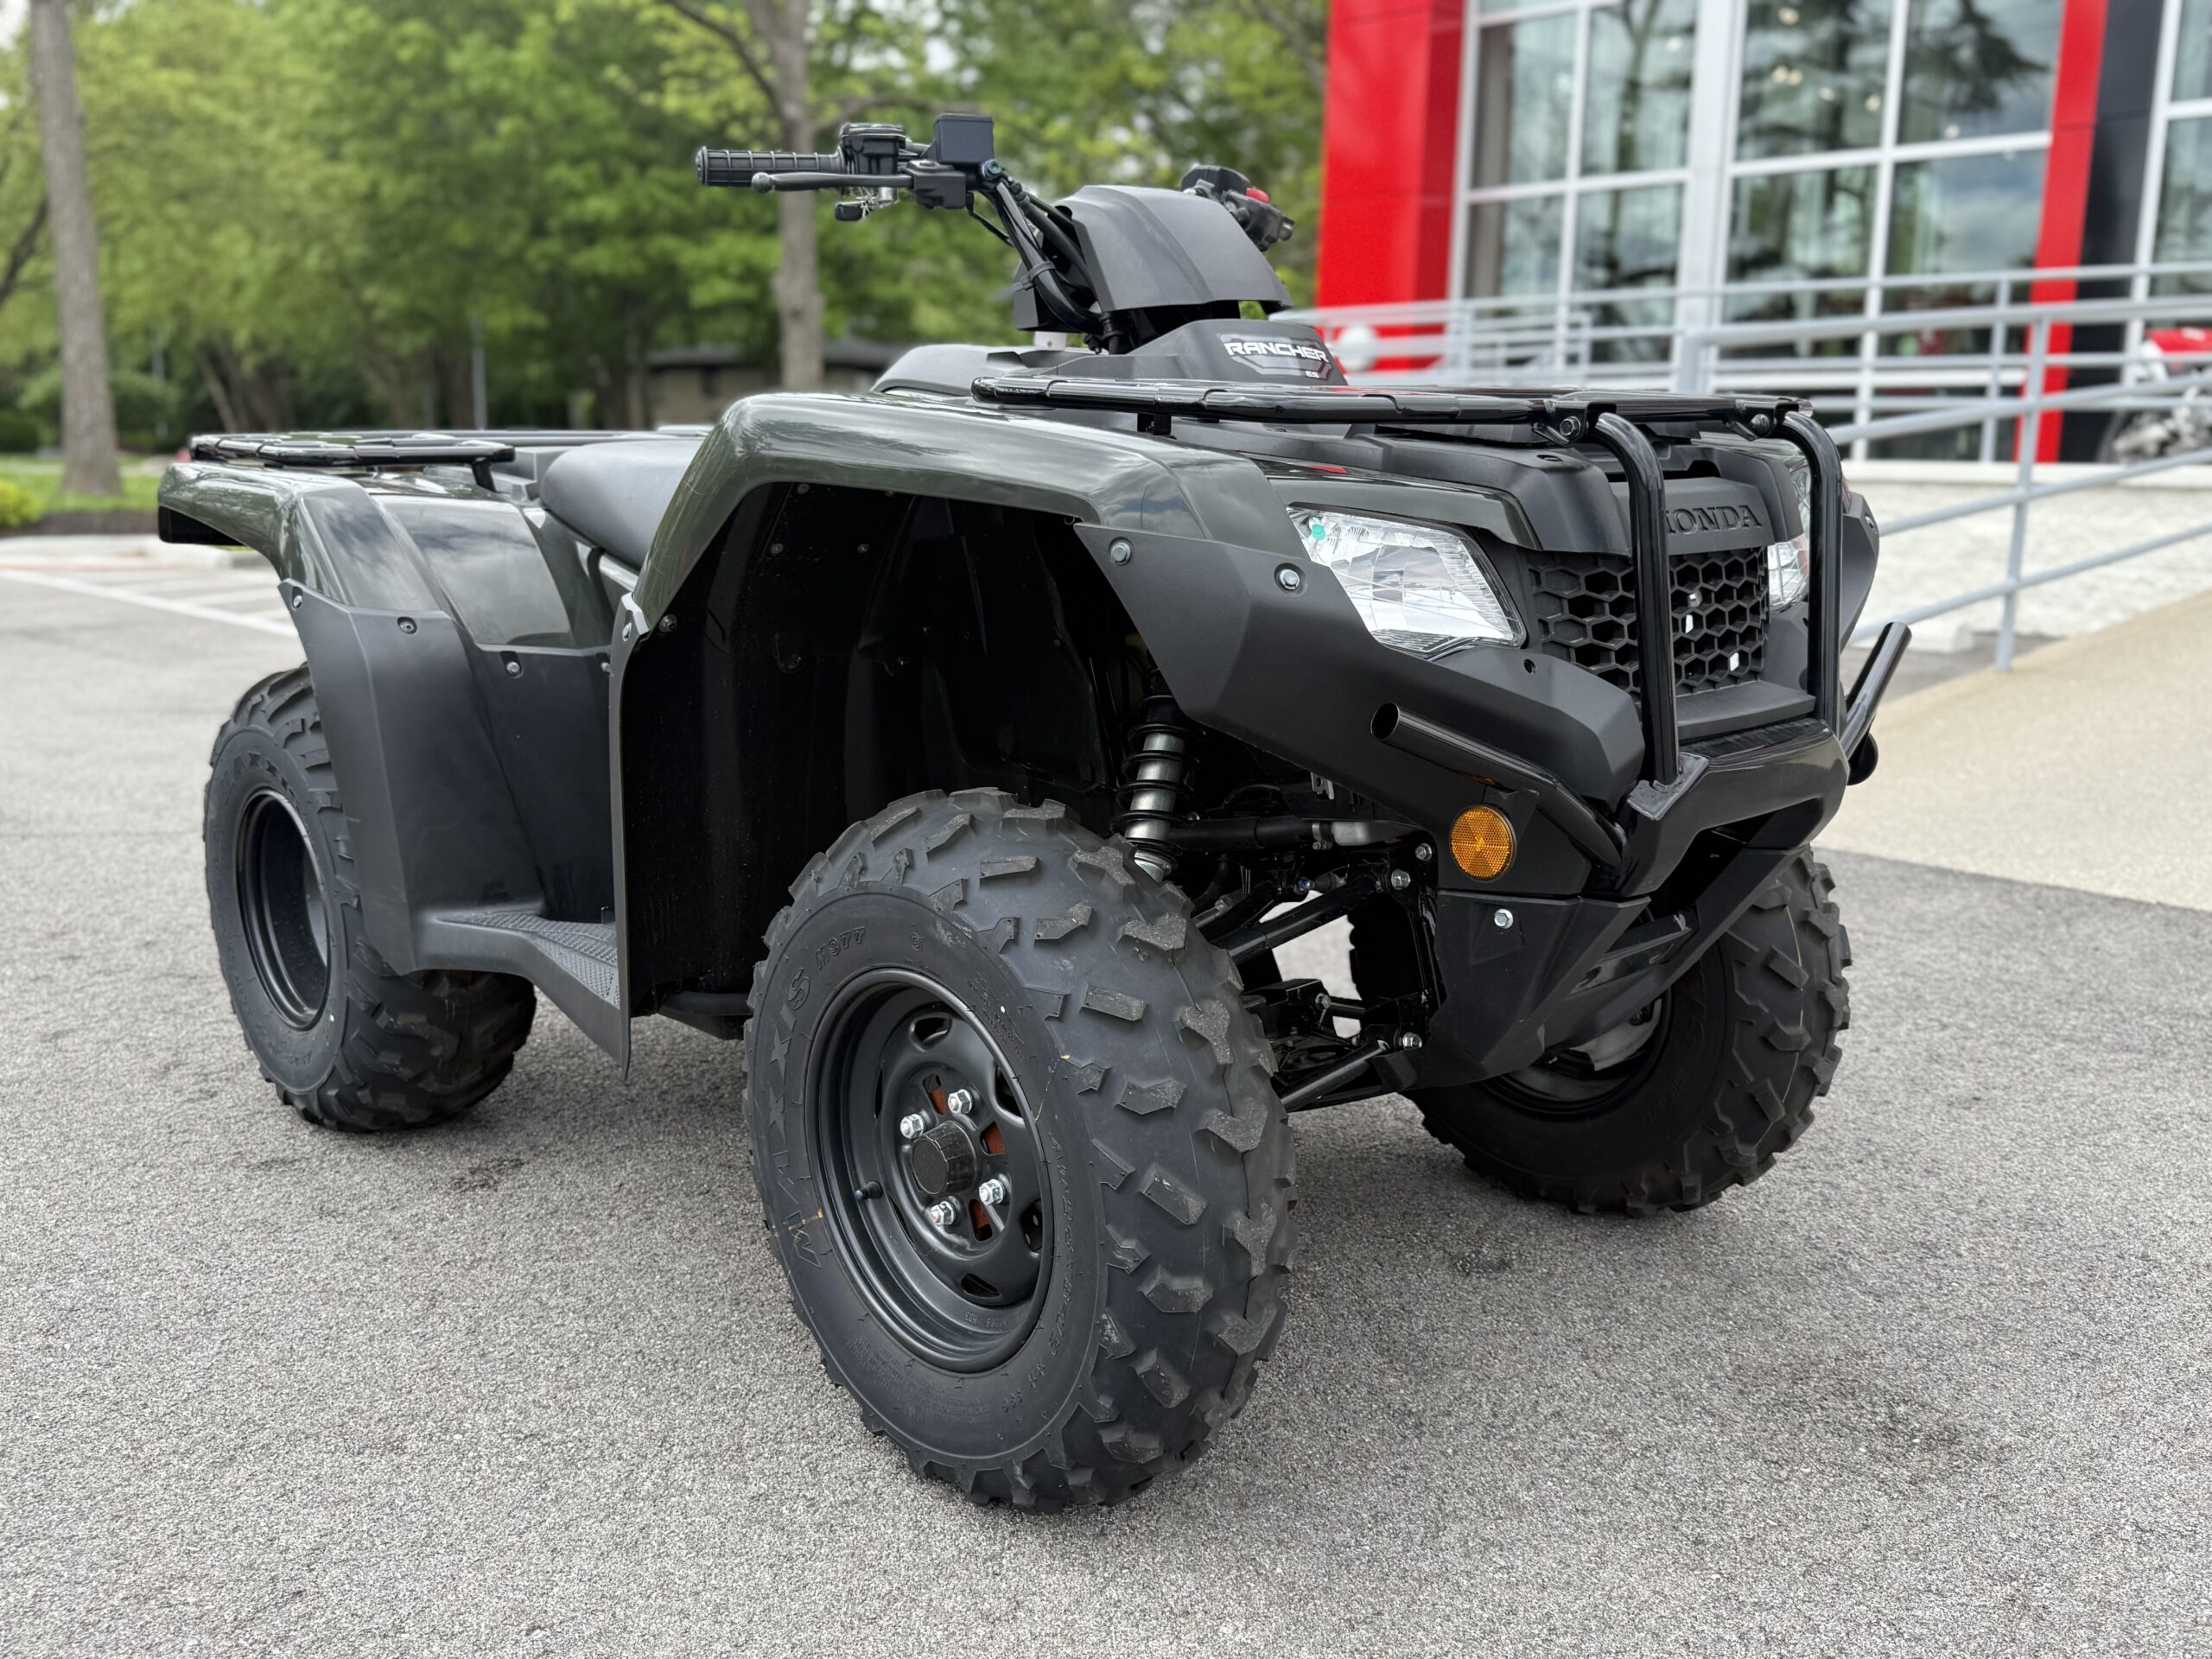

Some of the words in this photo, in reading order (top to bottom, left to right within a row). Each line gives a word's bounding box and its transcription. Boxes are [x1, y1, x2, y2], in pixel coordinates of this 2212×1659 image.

[1224, 341, 1331, 364] RANCHER
[767, 966, 823, 1268] MAXXIS
[815, 925, 866, 971] M977
